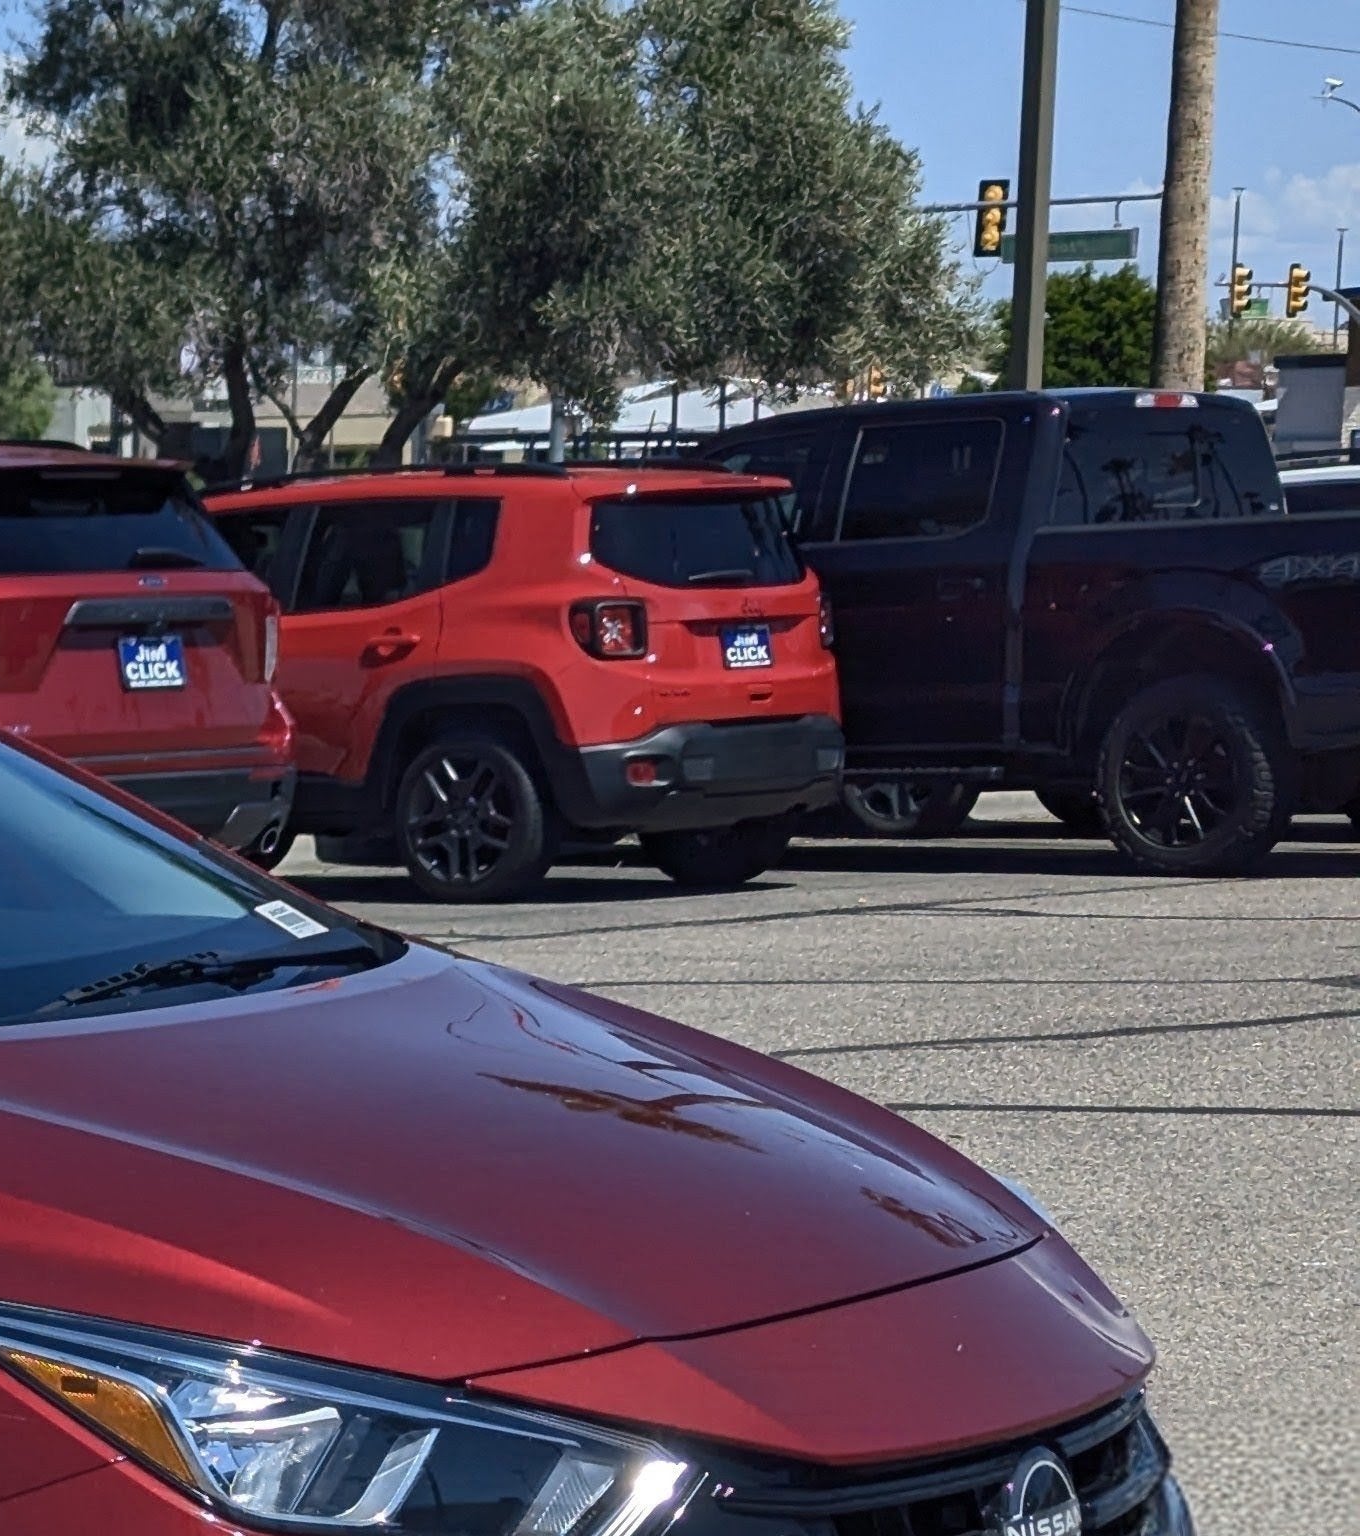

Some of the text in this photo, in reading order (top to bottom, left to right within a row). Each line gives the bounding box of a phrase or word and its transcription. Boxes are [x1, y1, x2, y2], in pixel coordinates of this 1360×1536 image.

[733, 633, 758, 646] JIM
[135, 643, 167, 662] JIM
[726, 645, 768, 661] CLICK
[126, 660, 180, 680] CLICK
